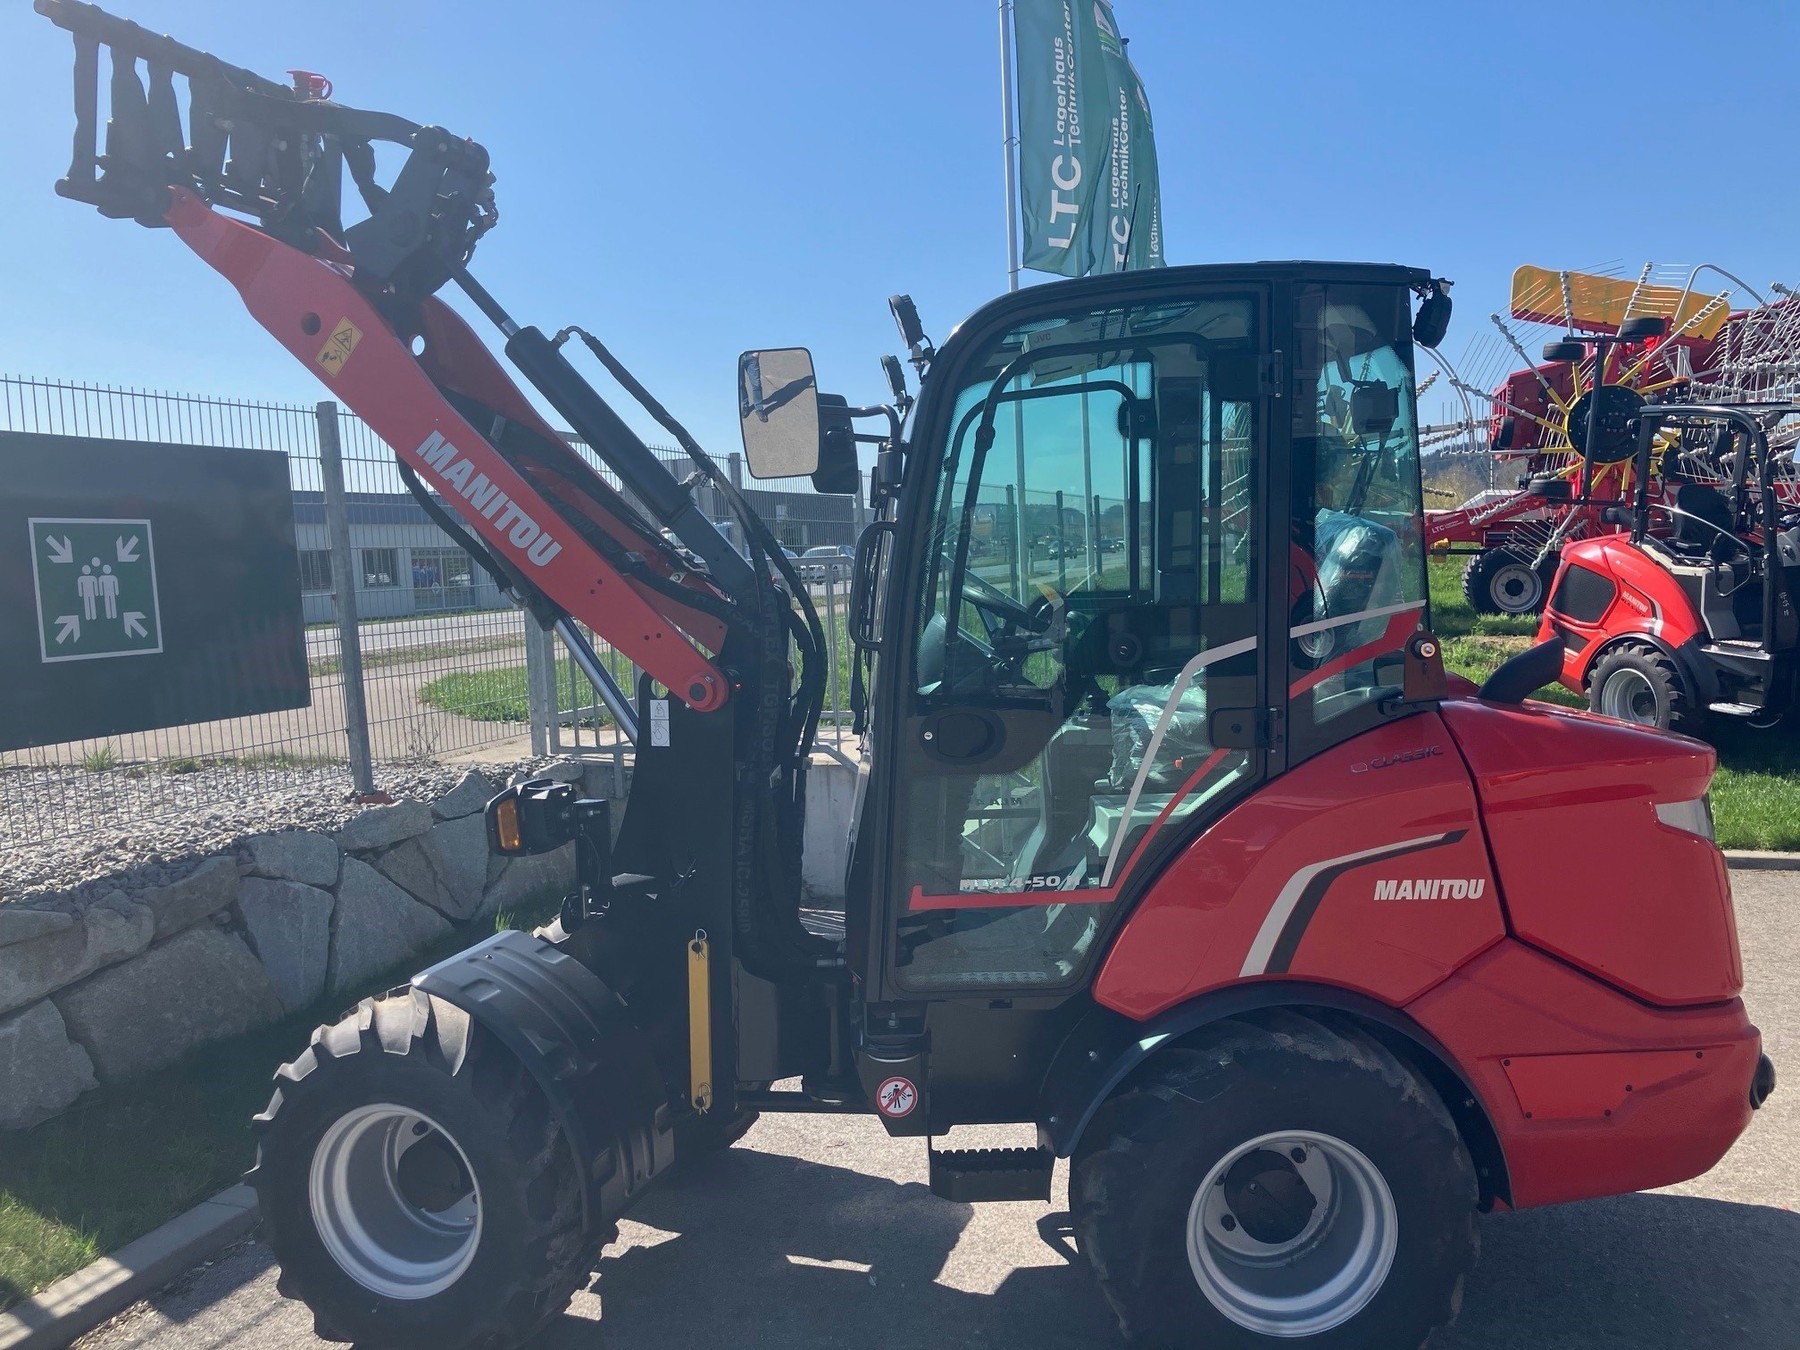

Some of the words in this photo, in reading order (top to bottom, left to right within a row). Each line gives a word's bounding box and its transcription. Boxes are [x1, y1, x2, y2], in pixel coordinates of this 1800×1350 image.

[1053, 37, 1067, 146] Lagerhaus
[1063, 1, 1081, 149] TechnikCenter
[1110, 117, 1120, 208] Lagerhaus
[1118, 86, 1130, 209] TechnikCenter
[1048, 154, 1082, 249] LTC
[415, 430, 563, 567] MANITOU
[1371, 745, 1443, 769] CLASSIC
[1009, 876, 1061, 888] 4-50
[1374, 879, 1485, 901] MANITOU
